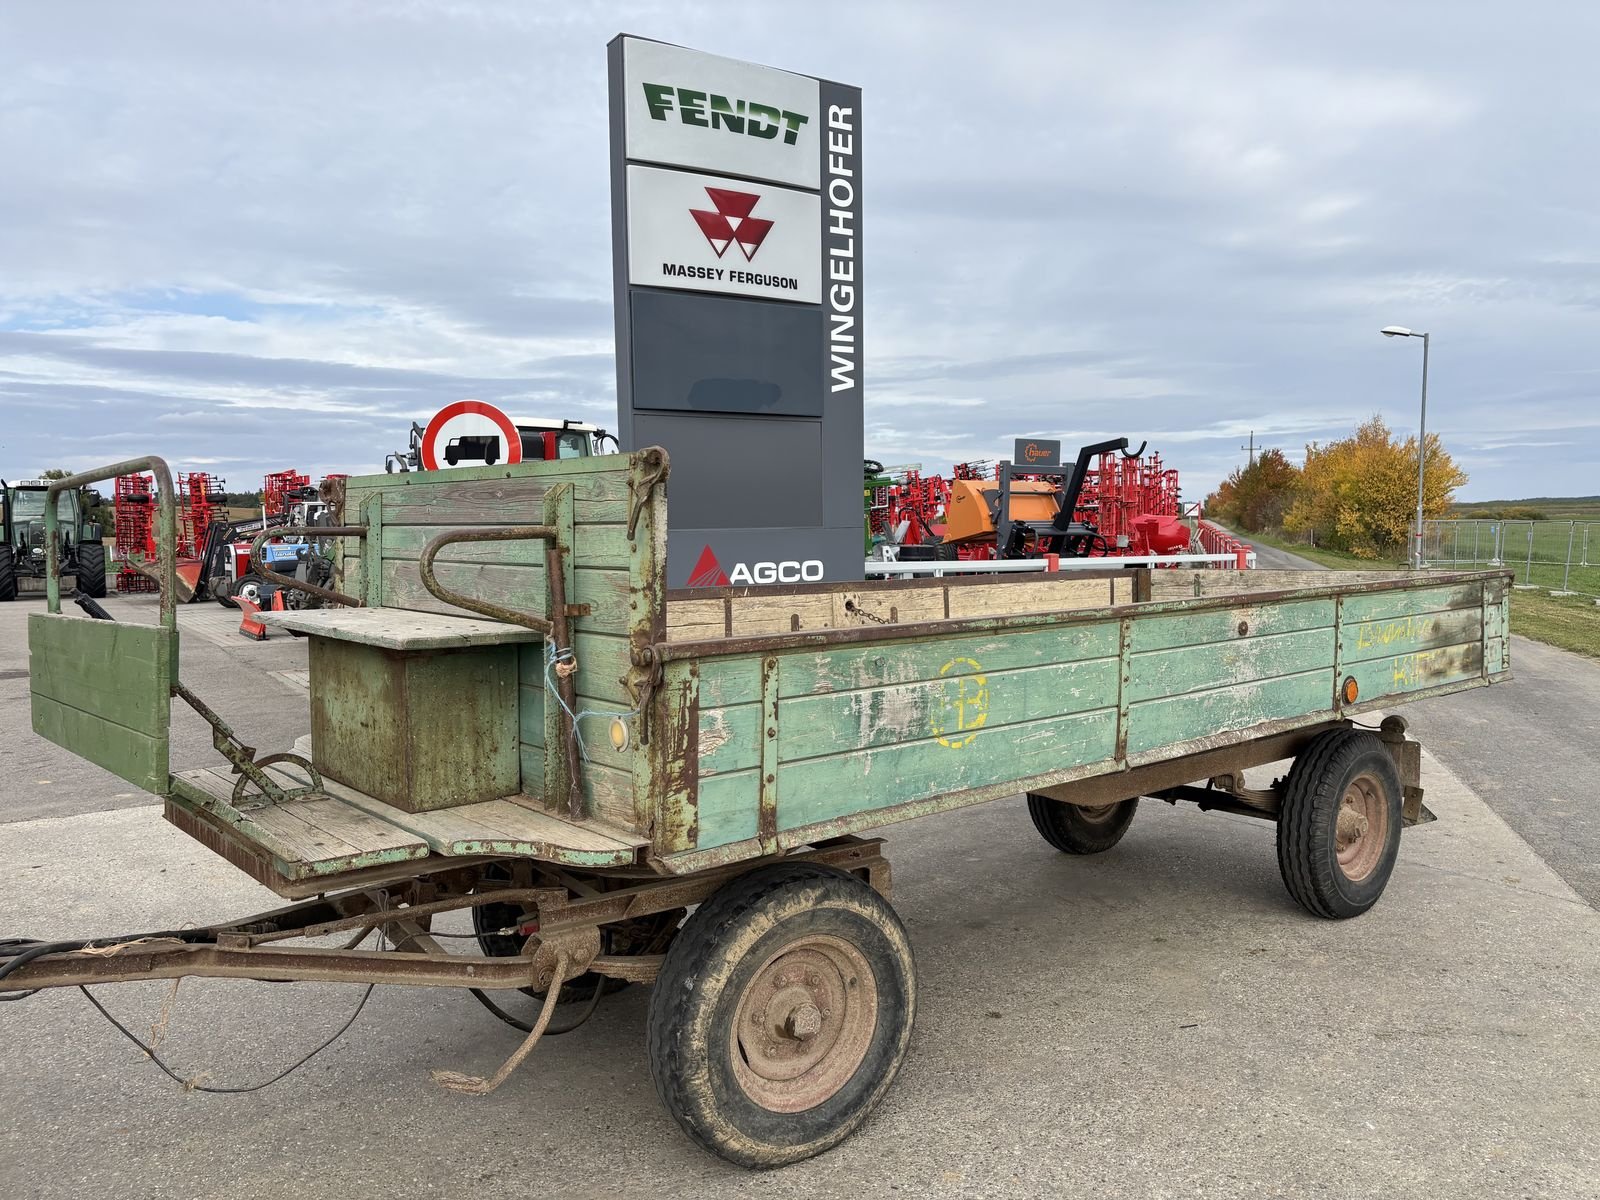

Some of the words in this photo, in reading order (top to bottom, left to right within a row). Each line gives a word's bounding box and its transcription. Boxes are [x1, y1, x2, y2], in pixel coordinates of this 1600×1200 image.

[642, 82, 809, 146] FENDT
[828, 104, 855, 393] WINGELHOFER
[662, 263, 724, 281] MASSEY
[729, 270, 798, 290] FERGUSON
[730, 559, 824, 585] AGCO
